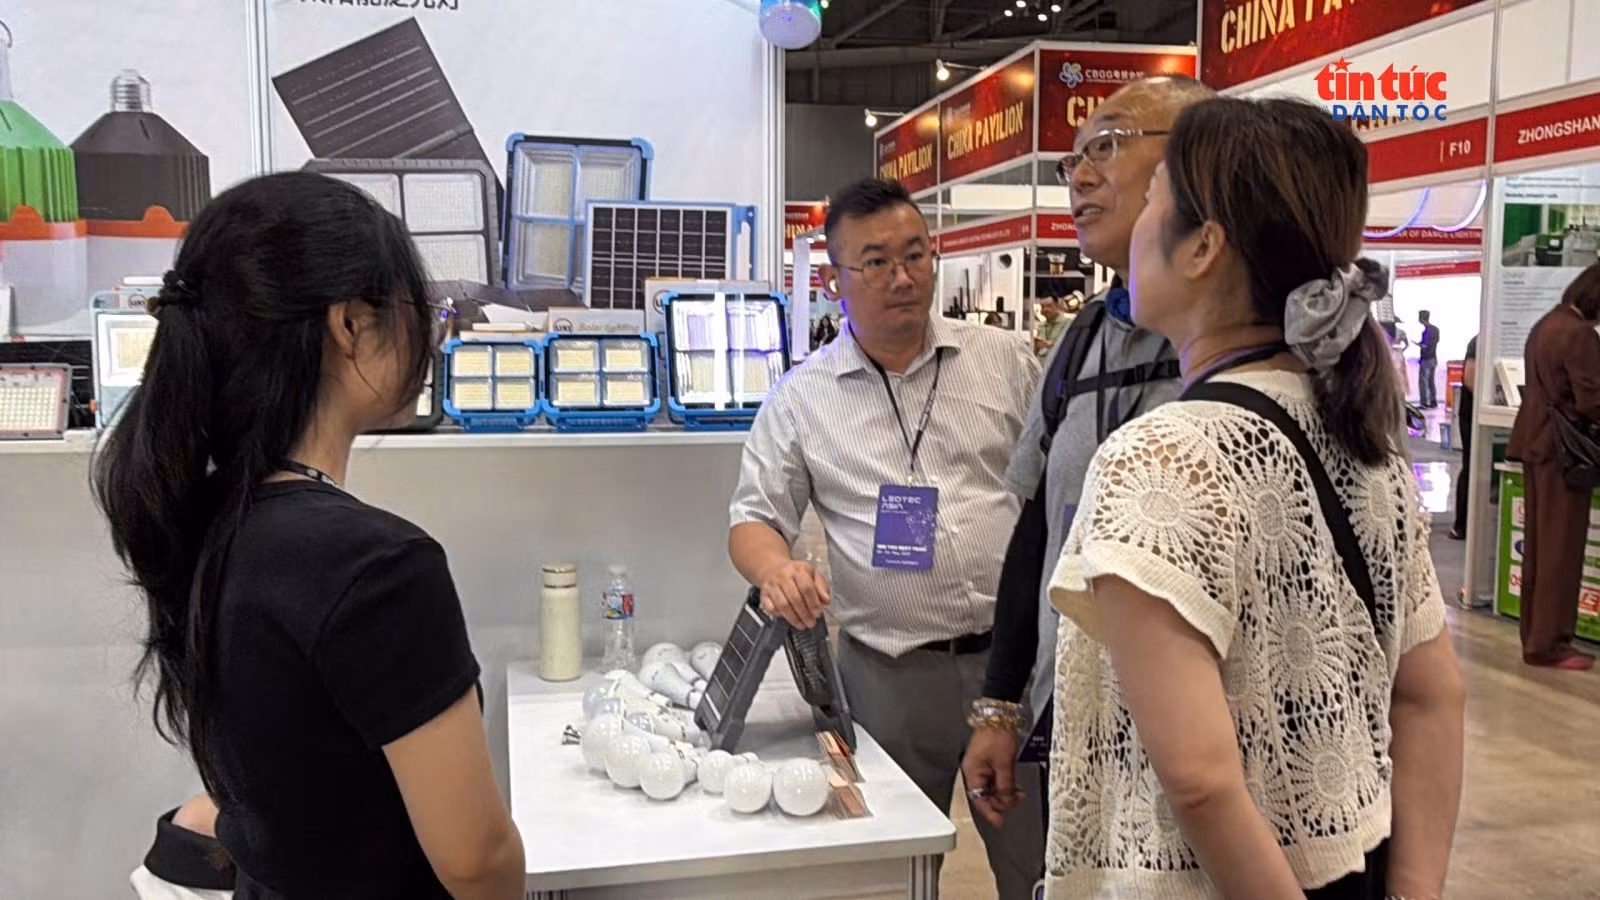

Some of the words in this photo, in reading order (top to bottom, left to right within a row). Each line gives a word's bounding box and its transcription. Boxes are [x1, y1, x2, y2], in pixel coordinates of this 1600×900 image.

[1221, 0, 1295, 54] CHINA
[947, 123, 974, 160] CHINA
[976, 101, 1024, 149] PAVILION
[1517, 114, 1600, 144] ZHONGSHAN
[898, 143, 933, 178] PAVILION
[1450, 140, 1471, 156] F10
